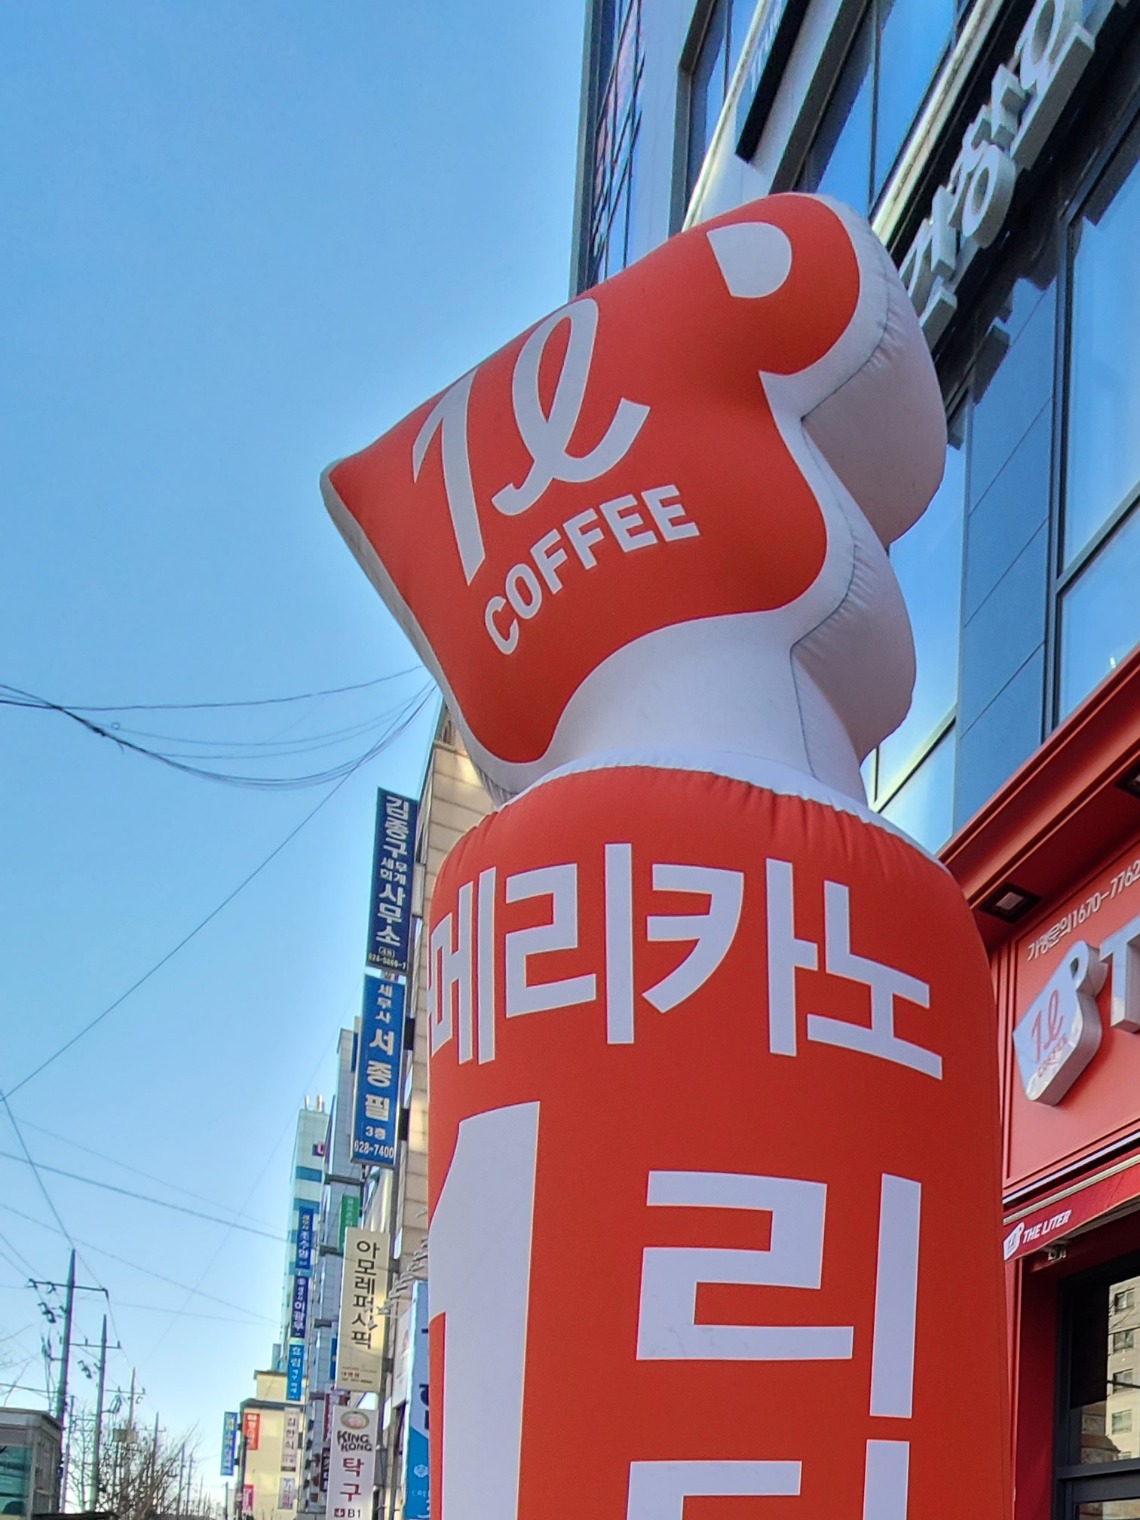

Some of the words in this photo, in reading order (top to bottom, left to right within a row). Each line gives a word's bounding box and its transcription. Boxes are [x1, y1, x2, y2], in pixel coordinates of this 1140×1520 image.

[484, 484, 700, 656] COFFEE
[375, 884, 407, 947] 사무소
[427, 842, 943, 1081] 메리카노
[1022, 1223, 1043, 1244] THE
[1041, 1209, 1072, 1235] LITER
[337, 1430, 369, 1447] KING
[341, 1442, 372, 1452] KONG
[339, 1457, 364, 1502] 탁구
[347, 1508, 361, 1519] B1
